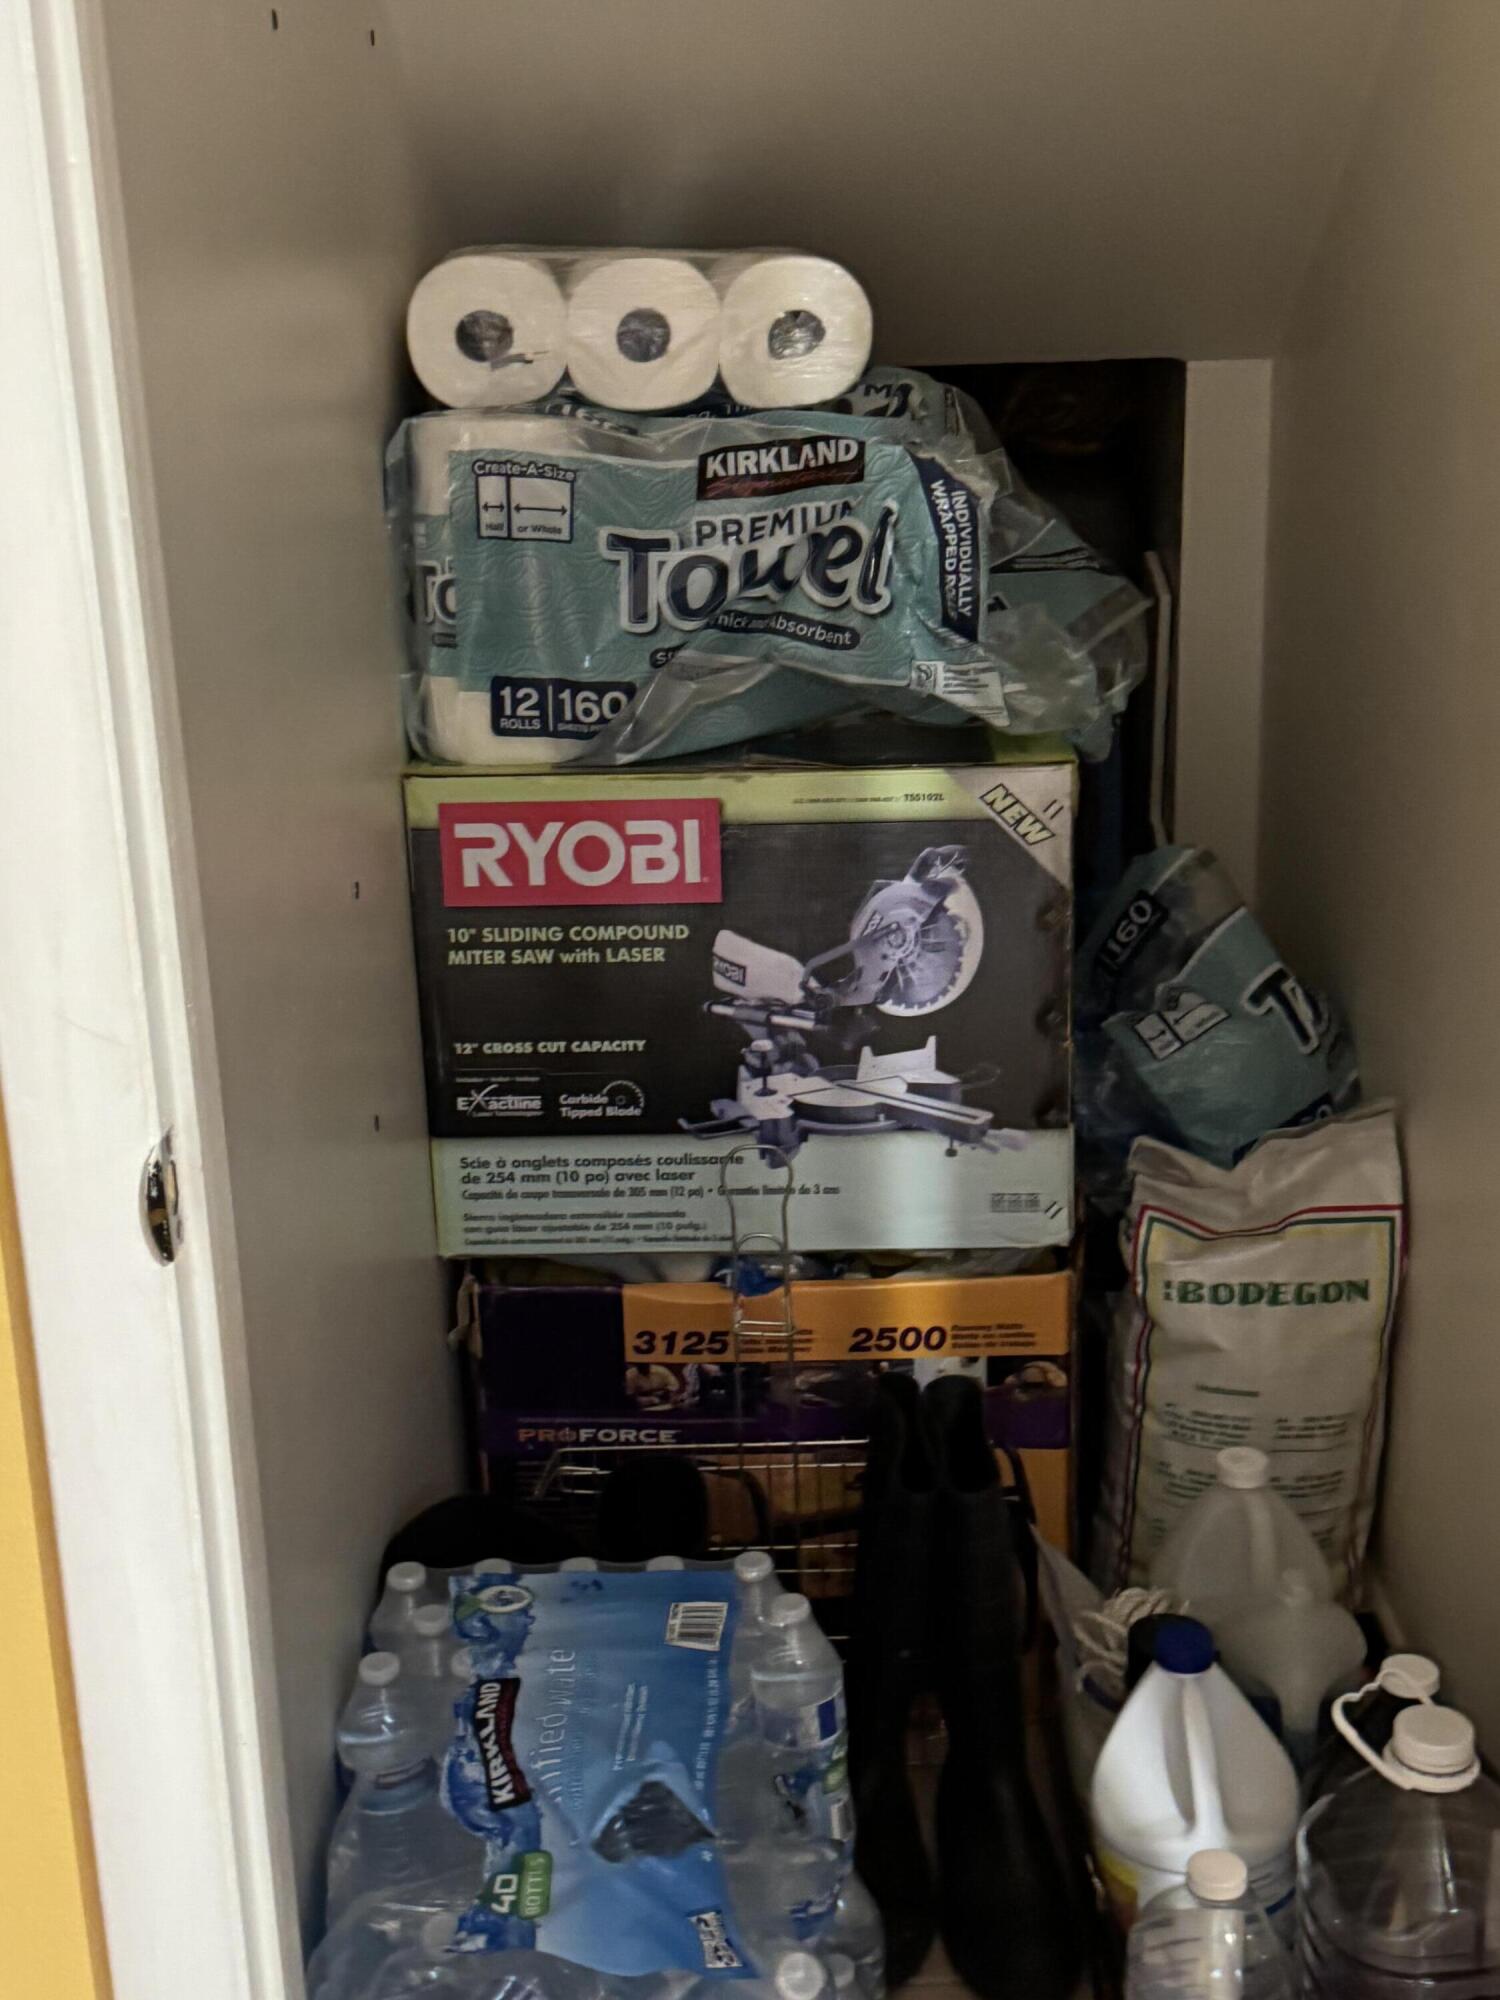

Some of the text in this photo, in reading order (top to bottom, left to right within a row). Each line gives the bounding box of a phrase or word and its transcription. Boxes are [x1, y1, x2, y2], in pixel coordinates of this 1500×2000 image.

[473, 460, 575, 480] Create-A-Size
[706, 438, 858, 478] KIRKLAND
[931, 479, 957, 572] WRAPPED
[951, 490, 973, 617] INDIVIDUALLY
[500, 686, 540, 717] 12
[558, 688, 629, 722] 160
[500, 719, 540, 729] ROLLS
[979, 783, 1056, 847] NEW
[454, 818, 700, 888] RYOBI
[448, 925, 689, 943] 10" SLIDING COMPOUND
[1107, 899, 1153, 954] 160
[448, 947, 665, 965] MITER SAW with LASER
[454, 1039, 646, 1055] 12" CROSS CUT CAPACITY
[559, 1094, 609, 1105] Carbide
[559, 1106, 604, 1119] Tipped
[606, 1106, 642, 1117] Blade
[460, 1156, 490, 1169] Scie
[512, 1155, 569, 1171] onglets
[574, 1155, 652, 1172] composés
[462, 1169, 695, 1185] de 254 mm (10 po) avec laser
[1177, 1279, 1369, 1307] BODEGON
[633, 1330, 731, 1356] 3125
[848, 1325, 947, 1352] 2500
[518, 1428, 682, 1443] PROFORCE
[475, 1682, 516, 1805] KIRKLAND
[490, 1873, 519, 1913] 40
